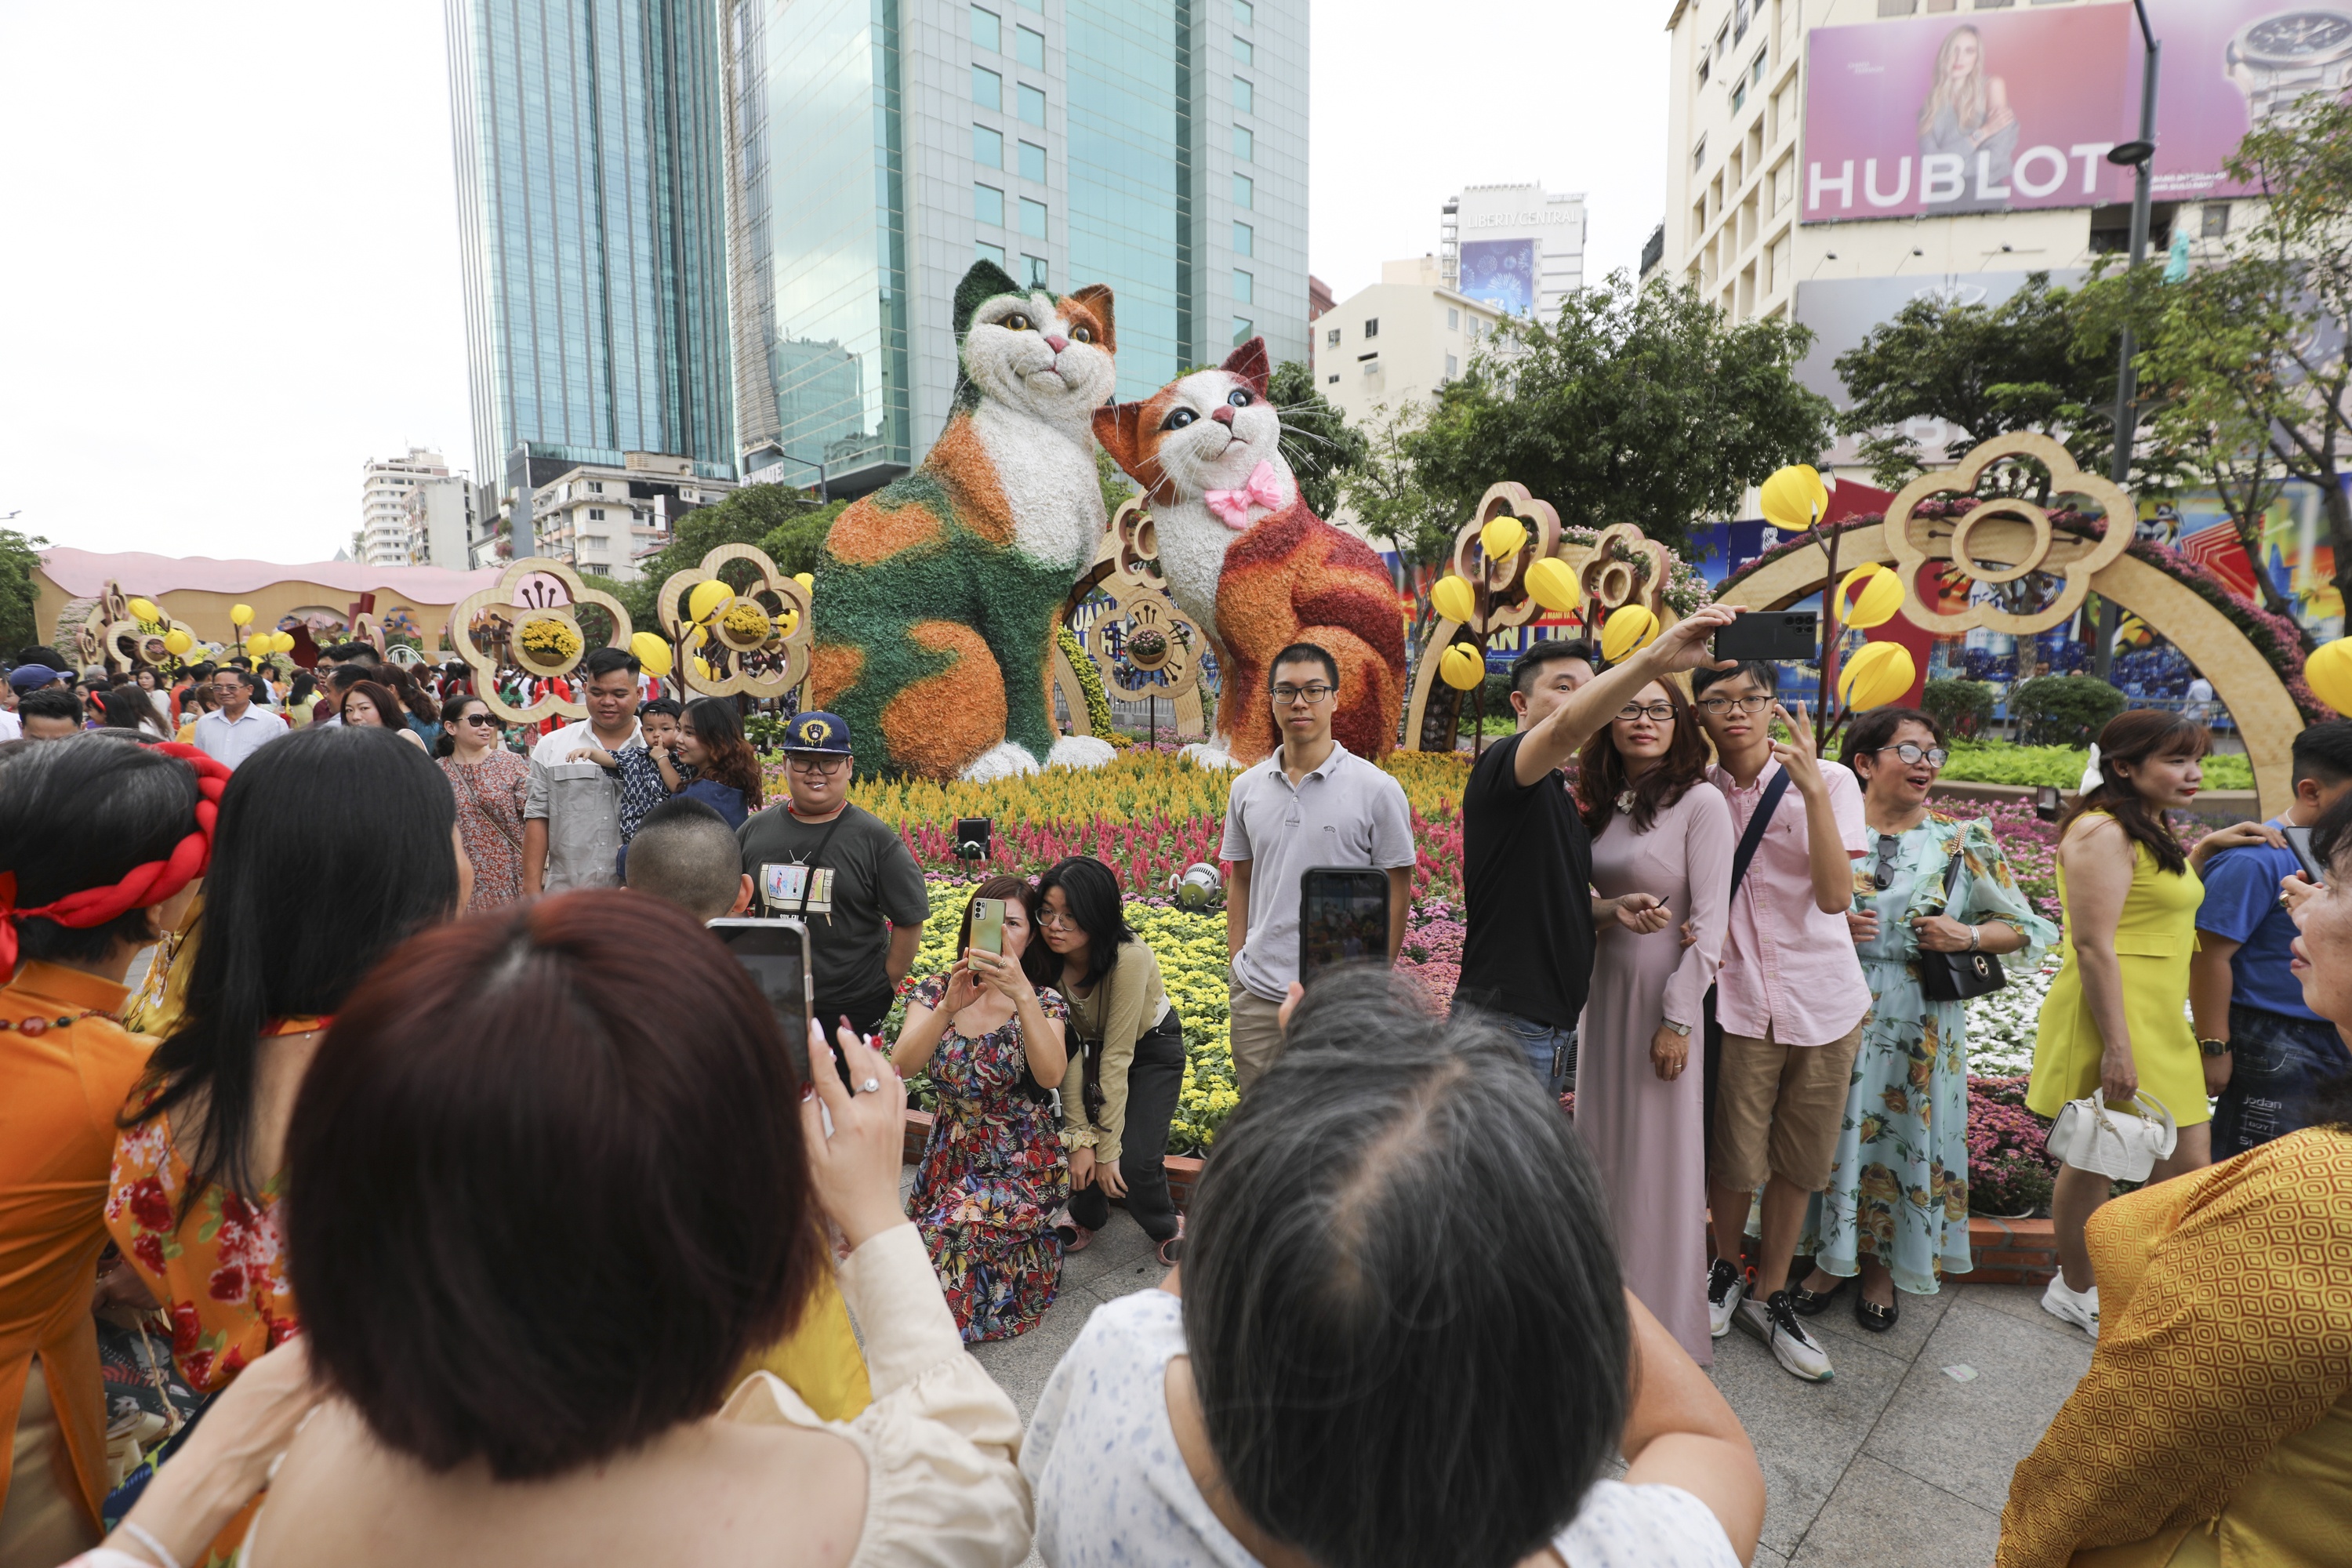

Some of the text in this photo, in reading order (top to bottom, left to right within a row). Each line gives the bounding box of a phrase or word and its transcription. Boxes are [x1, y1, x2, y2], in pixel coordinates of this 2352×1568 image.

[1808, 142, 2114, 210] HUBLOT
[1468, 209, 1578, 228] LIBERTY CENTRAL
[2243, 1094, 2282, 1109] Jodan
